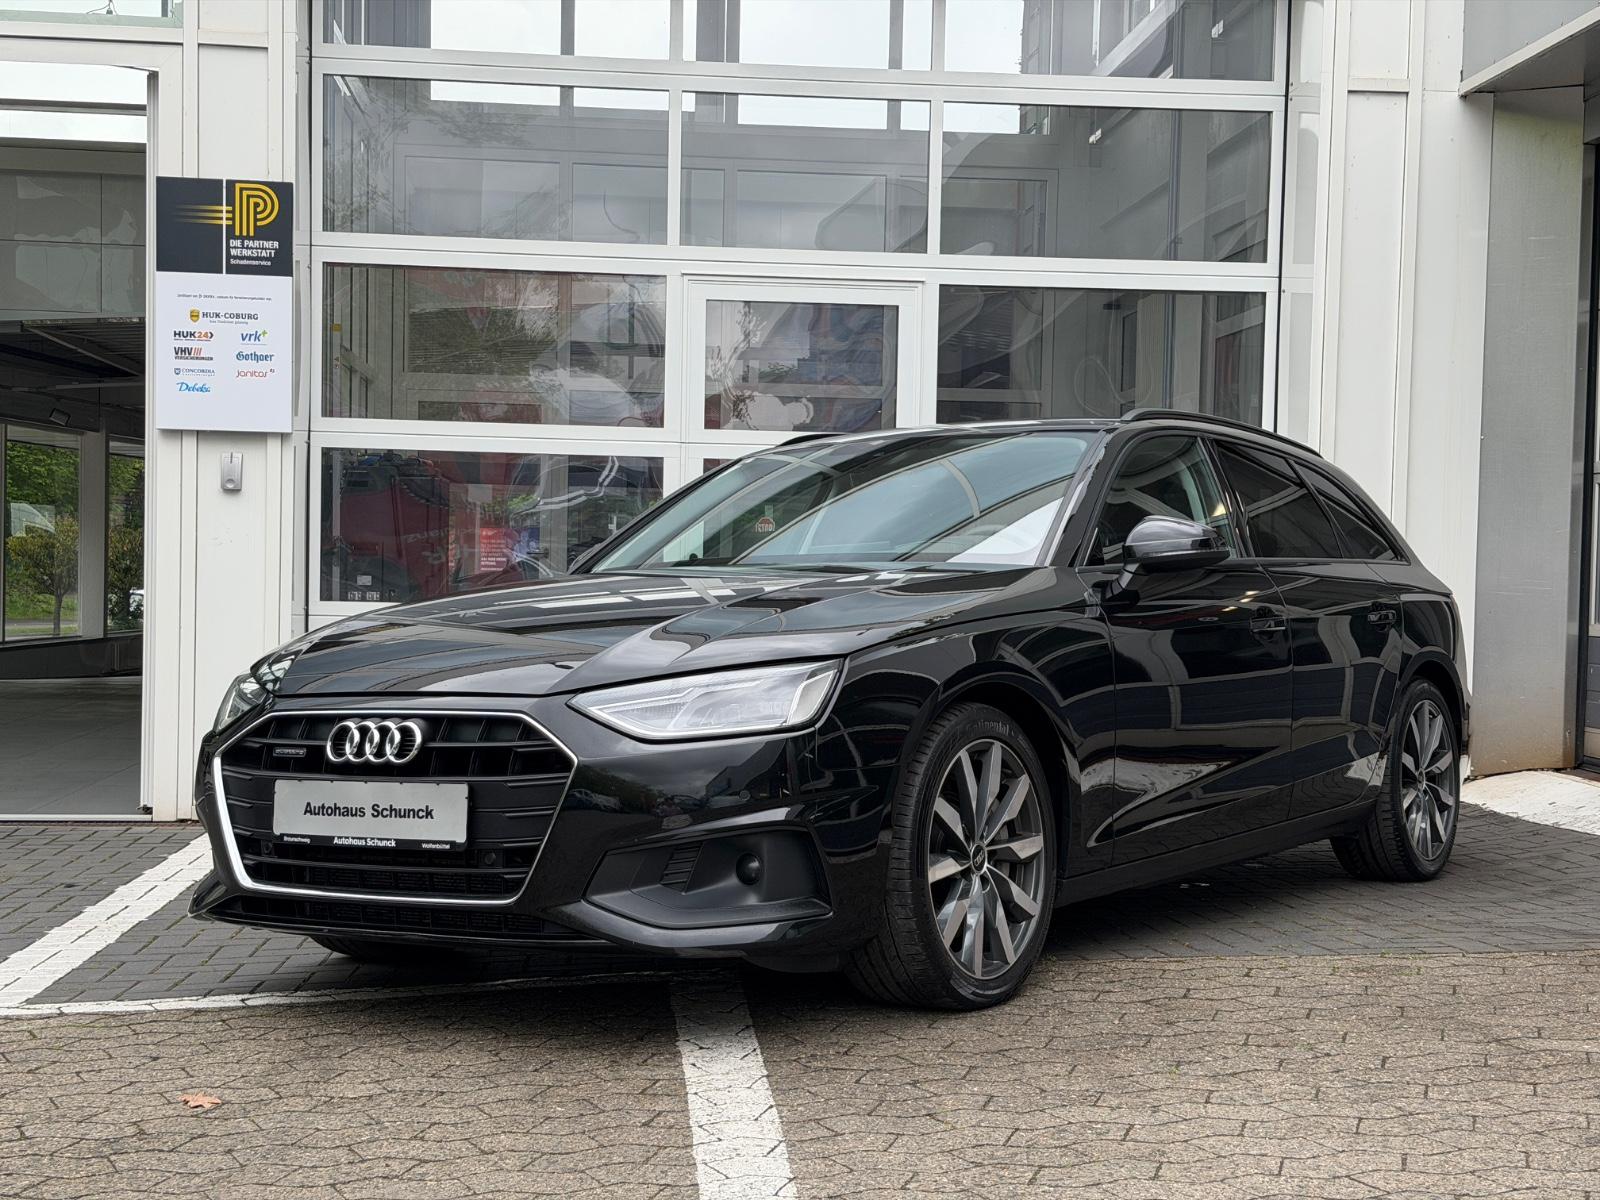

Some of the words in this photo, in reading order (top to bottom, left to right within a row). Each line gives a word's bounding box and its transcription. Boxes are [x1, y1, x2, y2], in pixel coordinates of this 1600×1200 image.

[229, 239, 242, 248] DIE
[244, 240, 279, 249] PARTNER
[229, 248, 276, 258] WERKSTATT
[201, 311, 259, 320] HUK-COBURG
[236, 350, 275, 363] Gothaer
[303, 802, 366, 818] Autohaus
[370, 803, 435, 820] Schunck
[333, 836, 366, 846] Autohaus
[366, 838, 396, 847] Schunck
